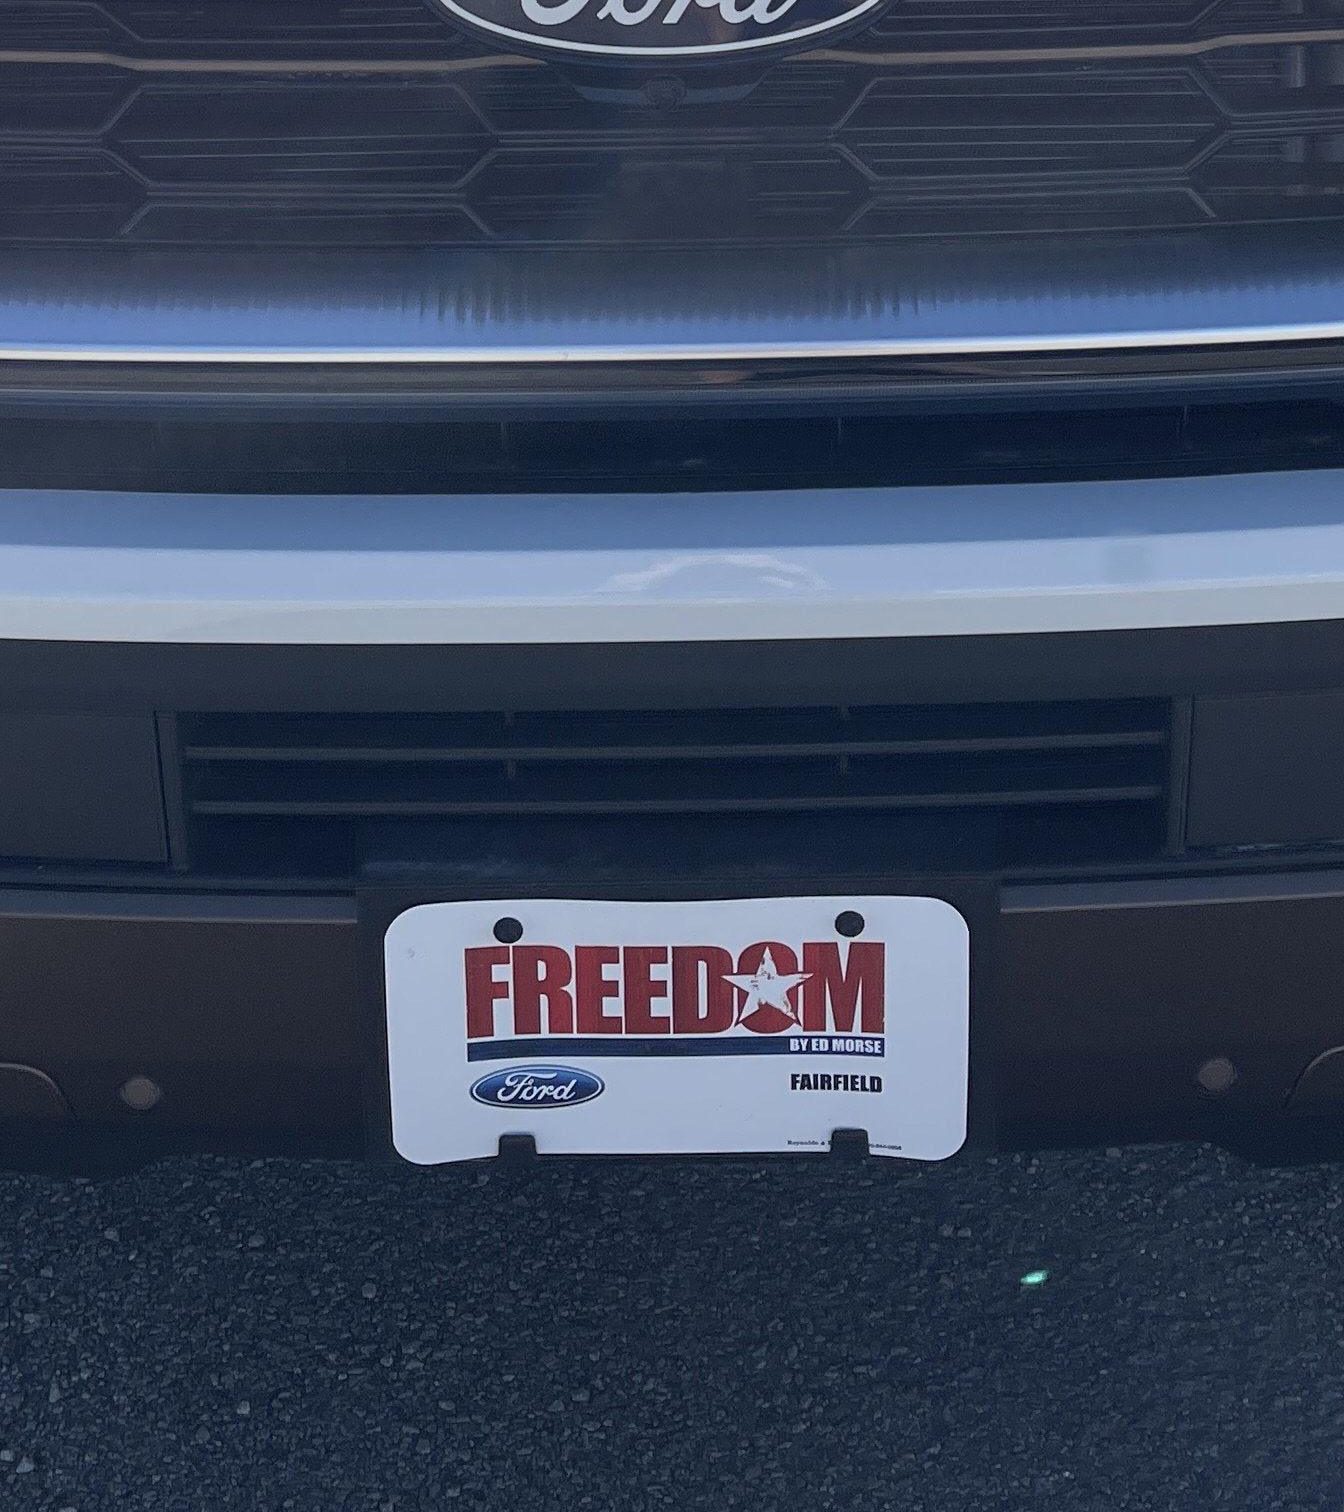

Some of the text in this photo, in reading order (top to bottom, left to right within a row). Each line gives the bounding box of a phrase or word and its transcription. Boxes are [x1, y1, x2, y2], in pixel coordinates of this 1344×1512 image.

[464, 942, 885, 1039] FREEDOM
[789, 1038, 882, 1054] BY ED MORSE
[496, 1071, 576, 1103] Ford
[790, 1073, 883, 1094] FAIRFIELD
